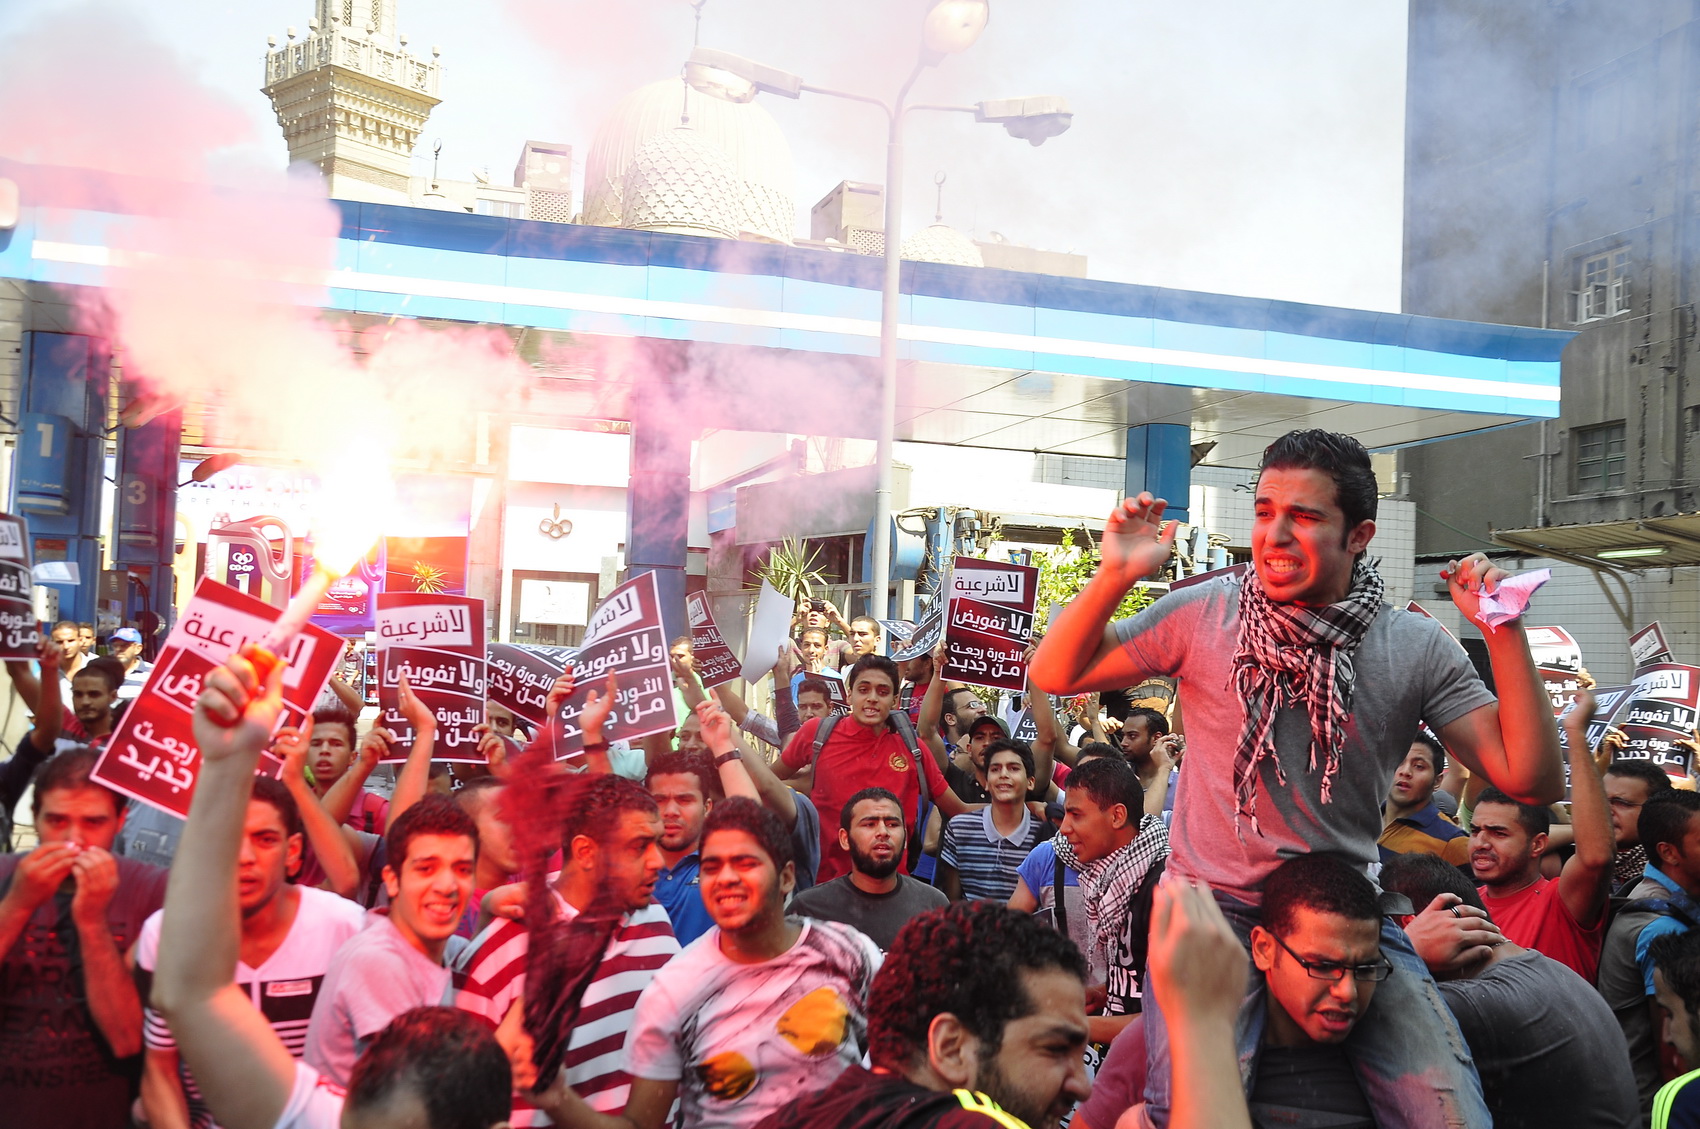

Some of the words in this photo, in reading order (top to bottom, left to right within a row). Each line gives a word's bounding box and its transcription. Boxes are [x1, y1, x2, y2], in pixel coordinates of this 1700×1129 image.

[37, 423, 54, 457] 1
[127, 481, 147, 505] 3
[229, 564, 254, 572] CO-OP
[236, 573, 250, 595] 1
[955, 609, 1007, 631] تفويض
[1008, 613, 1030, 640] ولا
[7, 631, 39, 648] من
[708, 629, 724, 644] ولا
[630, 634, 662, 663] ولا
[950, 642, 984, 659] رجعت
[987, 648, 1022, 663] الثورة
[387, 660, 456, 686] تفويض
[572, 646, 627, 678] تفويض
[702, 665, 724, 679] جديد
[725, 660, 739, 673] من
[948, 656, 988, 675] جديد
[991, 663, 1020, 678] من
[459, 660, 484, 694] ولا
[516, 666, 556, 692] الثورة
[516, 686, 546, 708] من
[436, 707, 480, 726] الثورة
[624, 697, 666, 725] من
[1626, 707, 1671, 724] تفويض
[1670, 707, 1694, 732] ولا
[132, 721, 198, 766] رجعت
[446, 728, 480, 748] من
[118, 744, 194, 794] جديد
[1652, 751, 1684, 766] من
